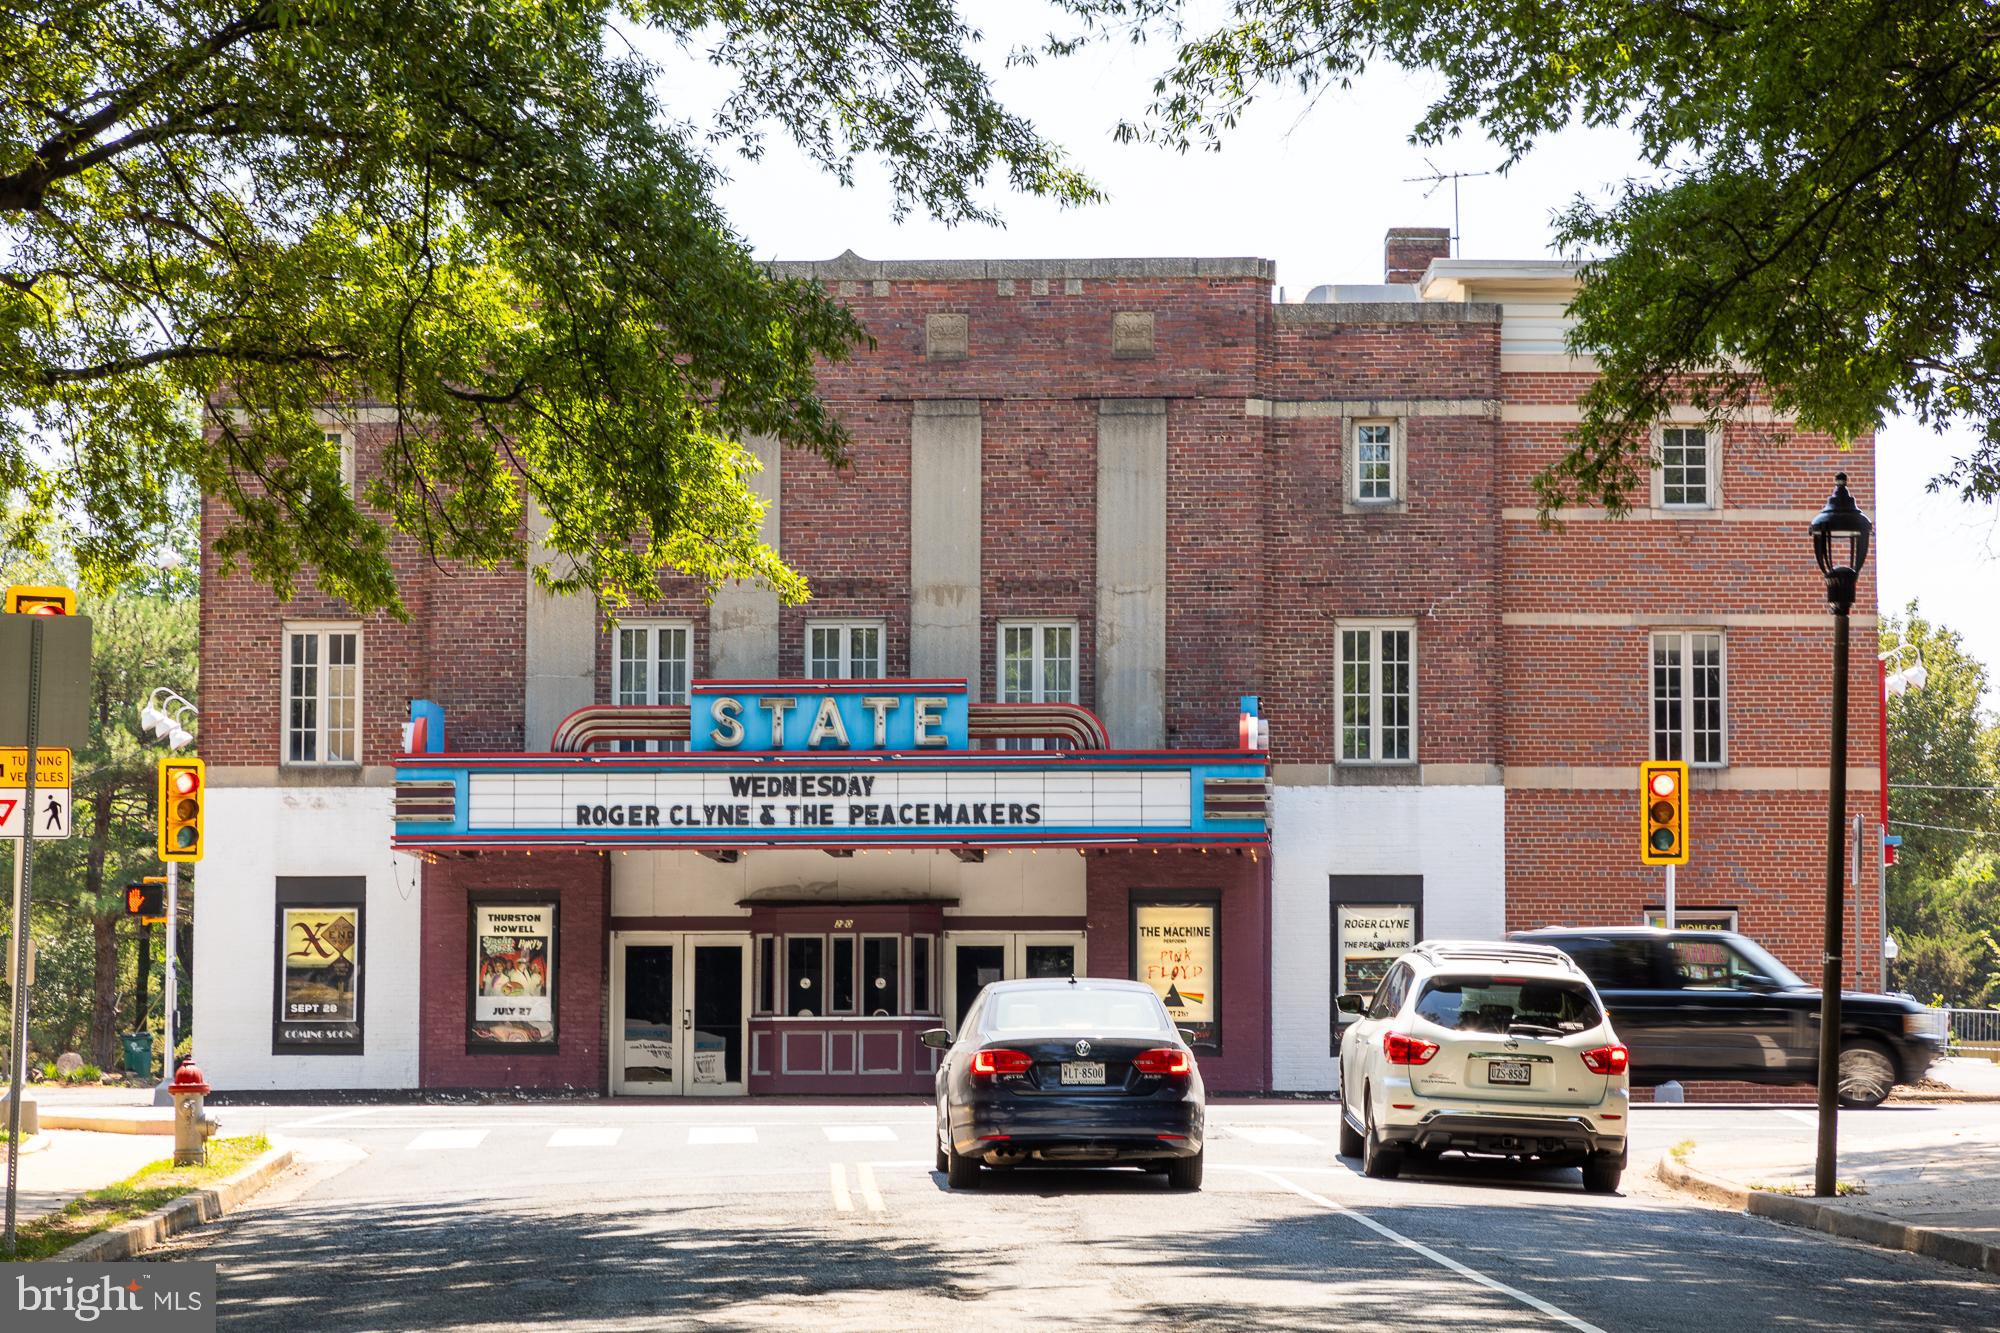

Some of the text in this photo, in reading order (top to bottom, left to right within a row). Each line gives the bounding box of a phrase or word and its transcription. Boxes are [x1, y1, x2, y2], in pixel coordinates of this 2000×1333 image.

[710, 697, 948, 747] STATE
[12, 756, 62, 766] TUNING
[10, 772, 63, 782] VECLES
[729, 775, 875, 797] WEDNESDAY
[576, 804, 1041, 826] ROGER CLYNE & THE PEACEMAKERS
[488, 914, 541, 922] THURSTON
[1344, 919, 1410, 928] ROGER CLYNE
[493, 925, 535, 933] HOWELL
[1140, 926, 1211, 937] THE MACHINE
[1160, 947, 1192, 963] PINK
[1147, 965, 1203, 980] FLOYD
[290, 1003, 338, 1013] SEPT 28
[493, 1007, 532, 1016] JULY 27
[284, 1030, 353, 1039] COMING SOON
